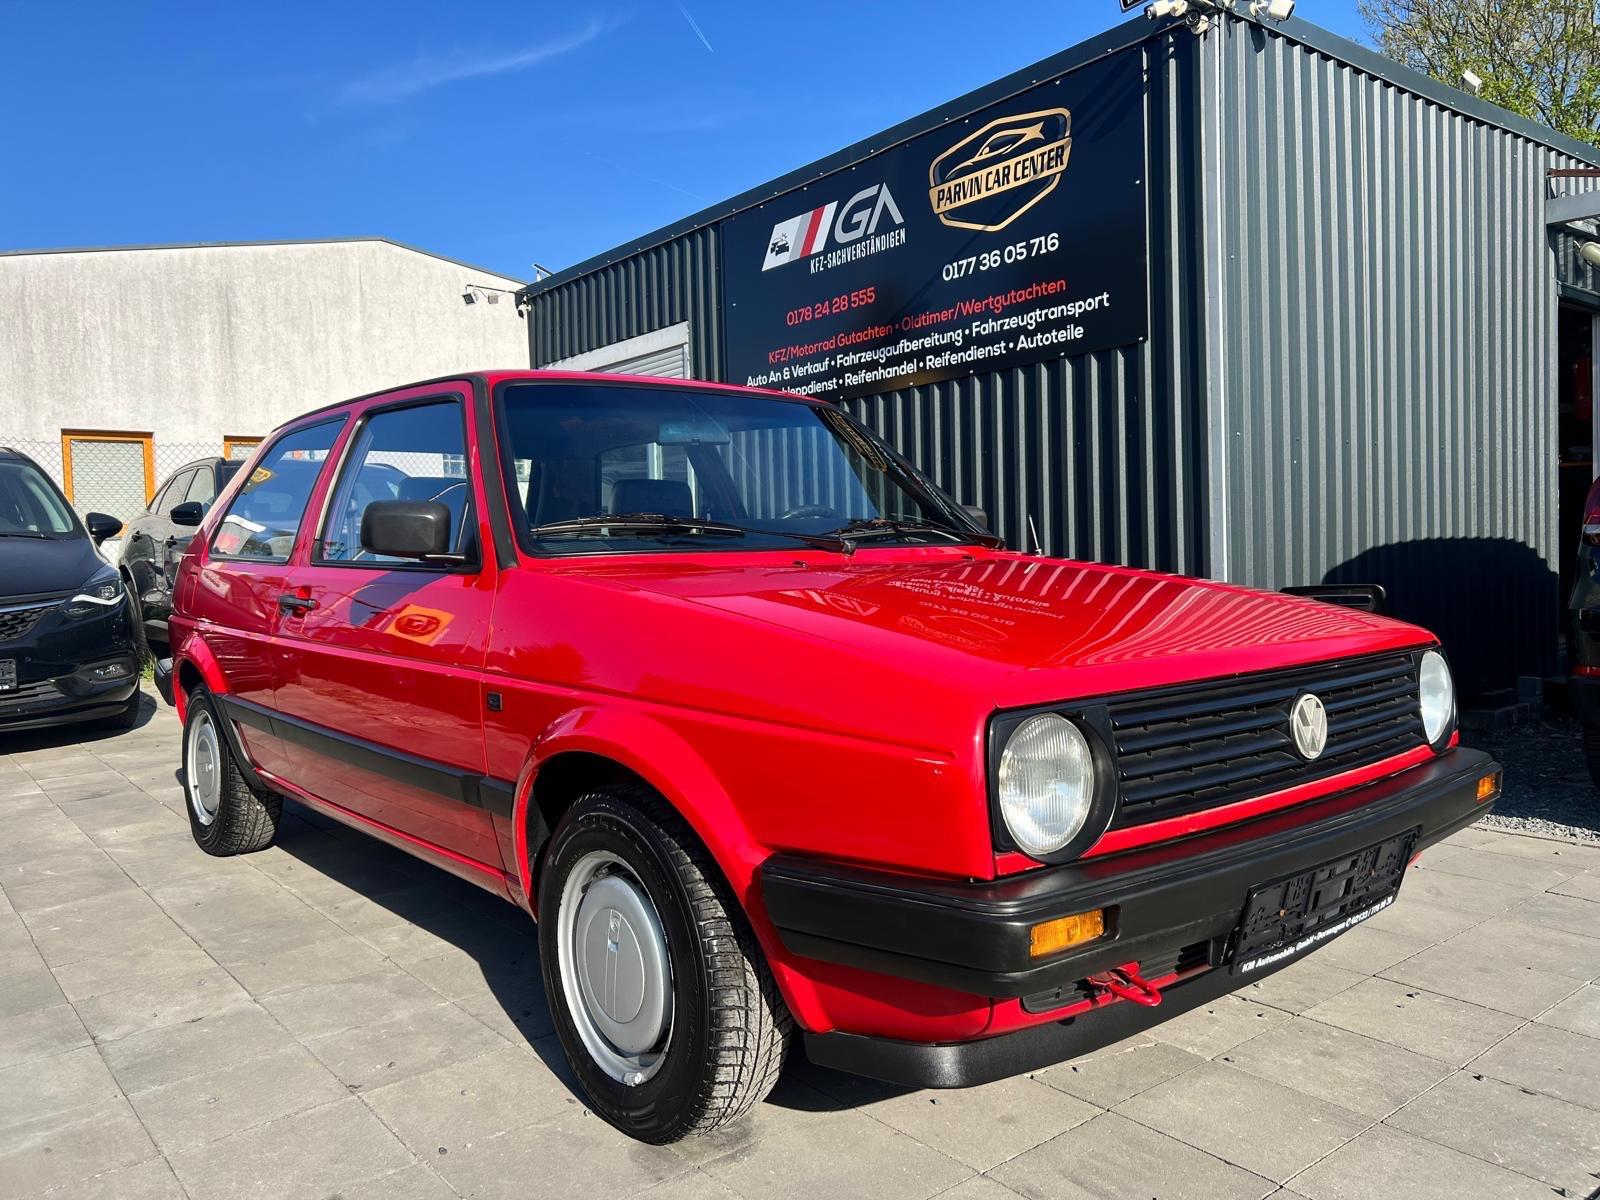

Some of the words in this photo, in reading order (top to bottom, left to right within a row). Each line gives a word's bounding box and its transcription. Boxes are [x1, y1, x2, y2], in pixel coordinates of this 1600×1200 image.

[936, 174, 983, 209] PARVIN
[985, 164, 1011, 192] CAR
[1013, 145, 1065, 182] CENTER
[834, 182, 905, 244] GA
[810, 227, 906, 274] KFZ-SACHVERSTÄNDIGEN
[942, 256, 976, 281] 0177
[979, 250, 1001, 270] 36
[1004, 242, 1027, 264] 05
[1030, 232, 1059, 257] 716
[768, 336, 836, 364] KFZ/Motorrad
[837, 324, 893, 347] Gutachten
[902, 279, 1066, 331] Oldtimer/Wertgutachten
[786, 306, 813, 326] 0178
[814, 301, 830, 318] 24
[832, 295, 849, 313] 28
[850, 287, 876, 308] 555
[746, 374, 768, 388] Auto
[768, 371, 782, 384] An
[783, 367, 791, 380] &
[791, 357, 830, 378] Verkauf
[836, 328, 963, 368] Fahrzeugaufbereitung
[972, 291, 1110, 337] Fahrzeugtransport
[844, 359, 917, 386] Reifenhandel
[926, 340, 1007, 370] Reifendienst
[1016, 324, 1084, 351] Autoteile
[1256, 946, 1295, 967] Automobile
